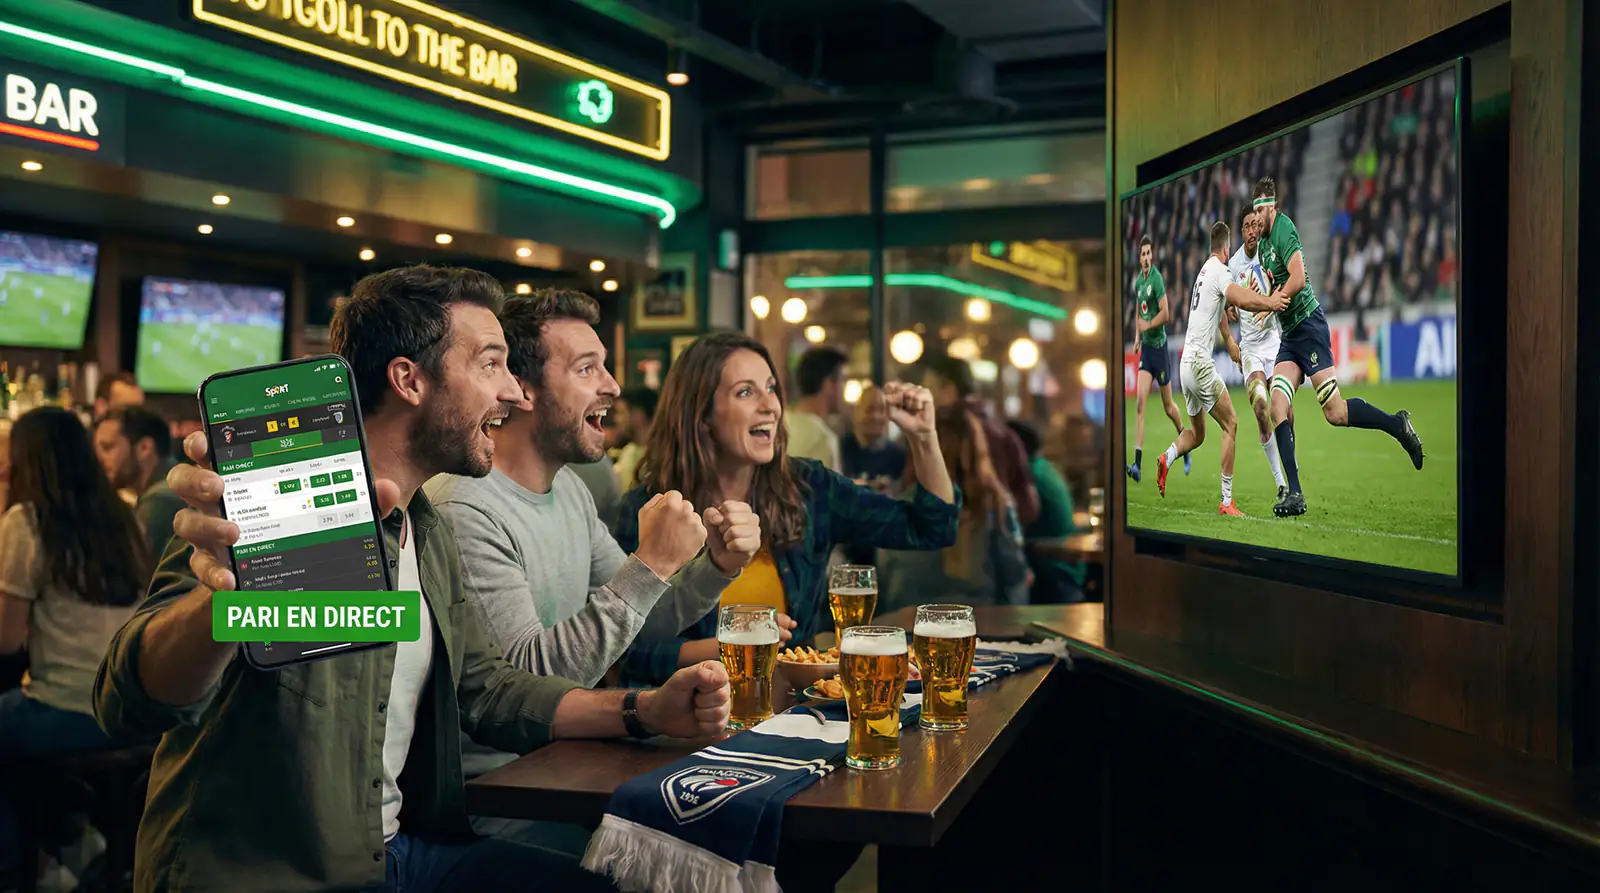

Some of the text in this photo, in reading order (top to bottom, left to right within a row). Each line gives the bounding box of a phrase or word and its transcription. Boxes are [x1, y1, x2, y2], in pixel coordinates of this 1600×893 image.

[371, 10, 410, 57] TO
[413, 23, 467, 77] THE
[468, 43, 518, 93] BAR
[6, 73, 99, 137] BAR
